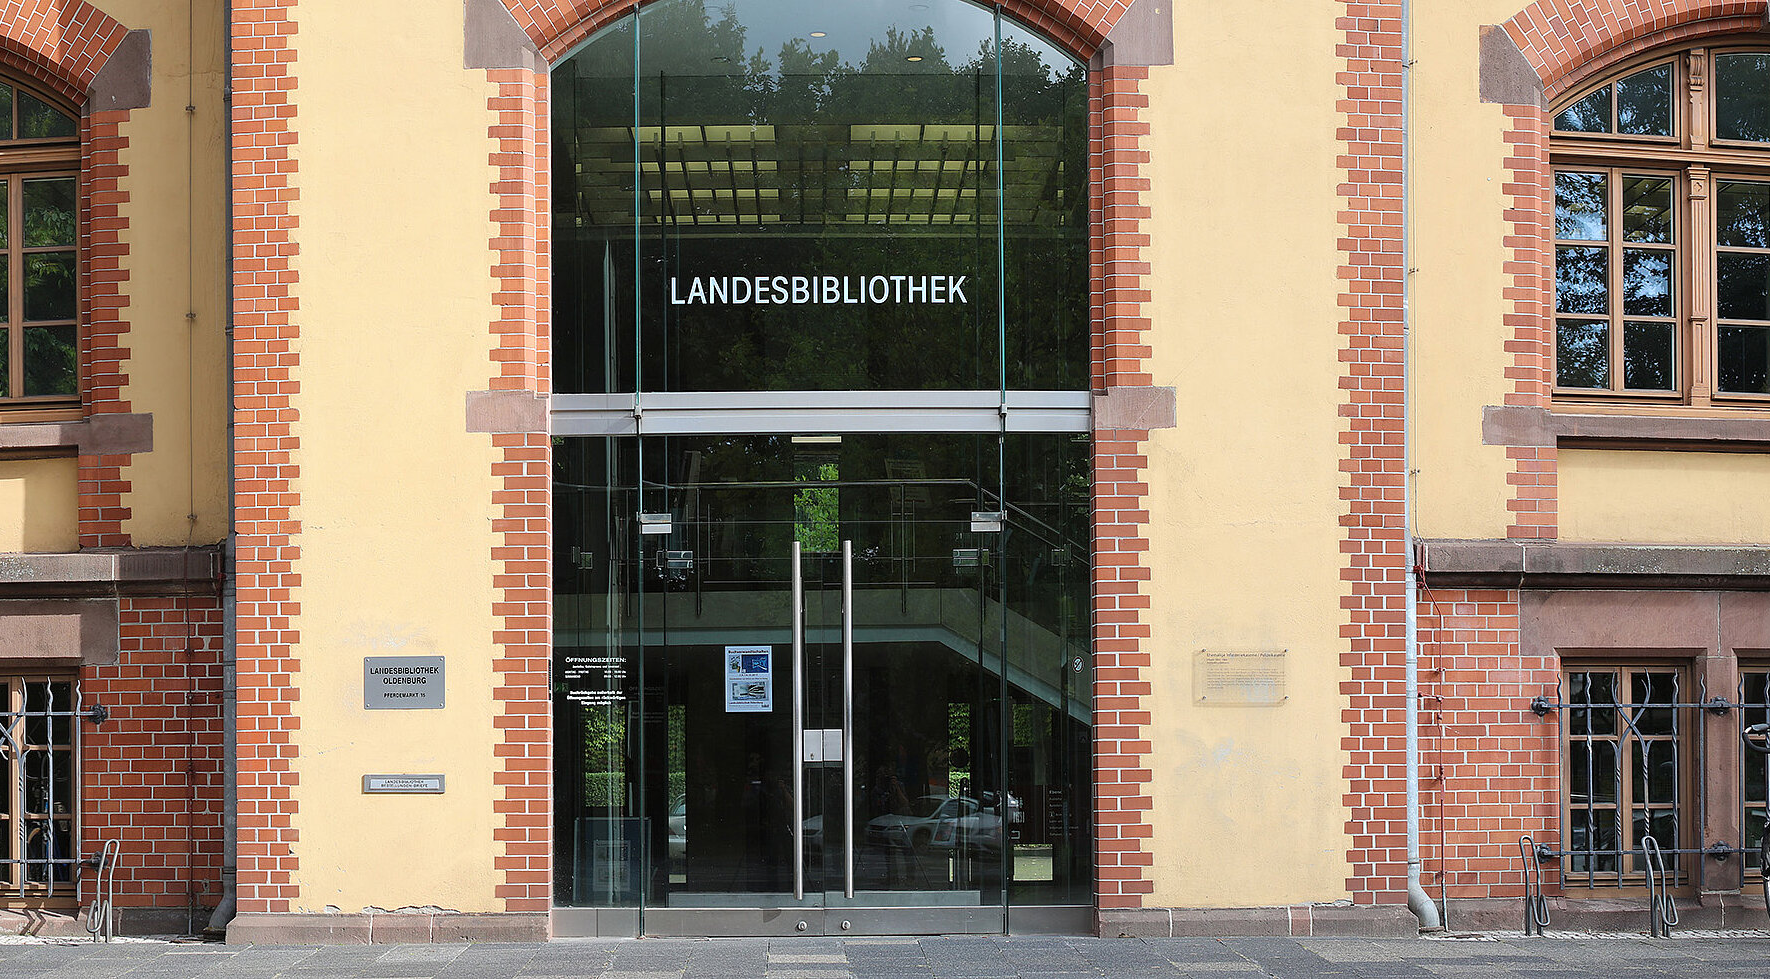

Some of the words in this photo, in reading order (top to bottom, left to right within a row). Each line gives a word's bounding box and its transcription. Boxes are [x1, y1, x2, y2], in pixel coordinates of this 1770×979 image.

[670, 275, 968, 305] LANDESBIBLIOTHEK
[370, 666, 440, 675] LANDESBIBLIOTHEK
[382, 676, 427, 685] OLDENBURG
